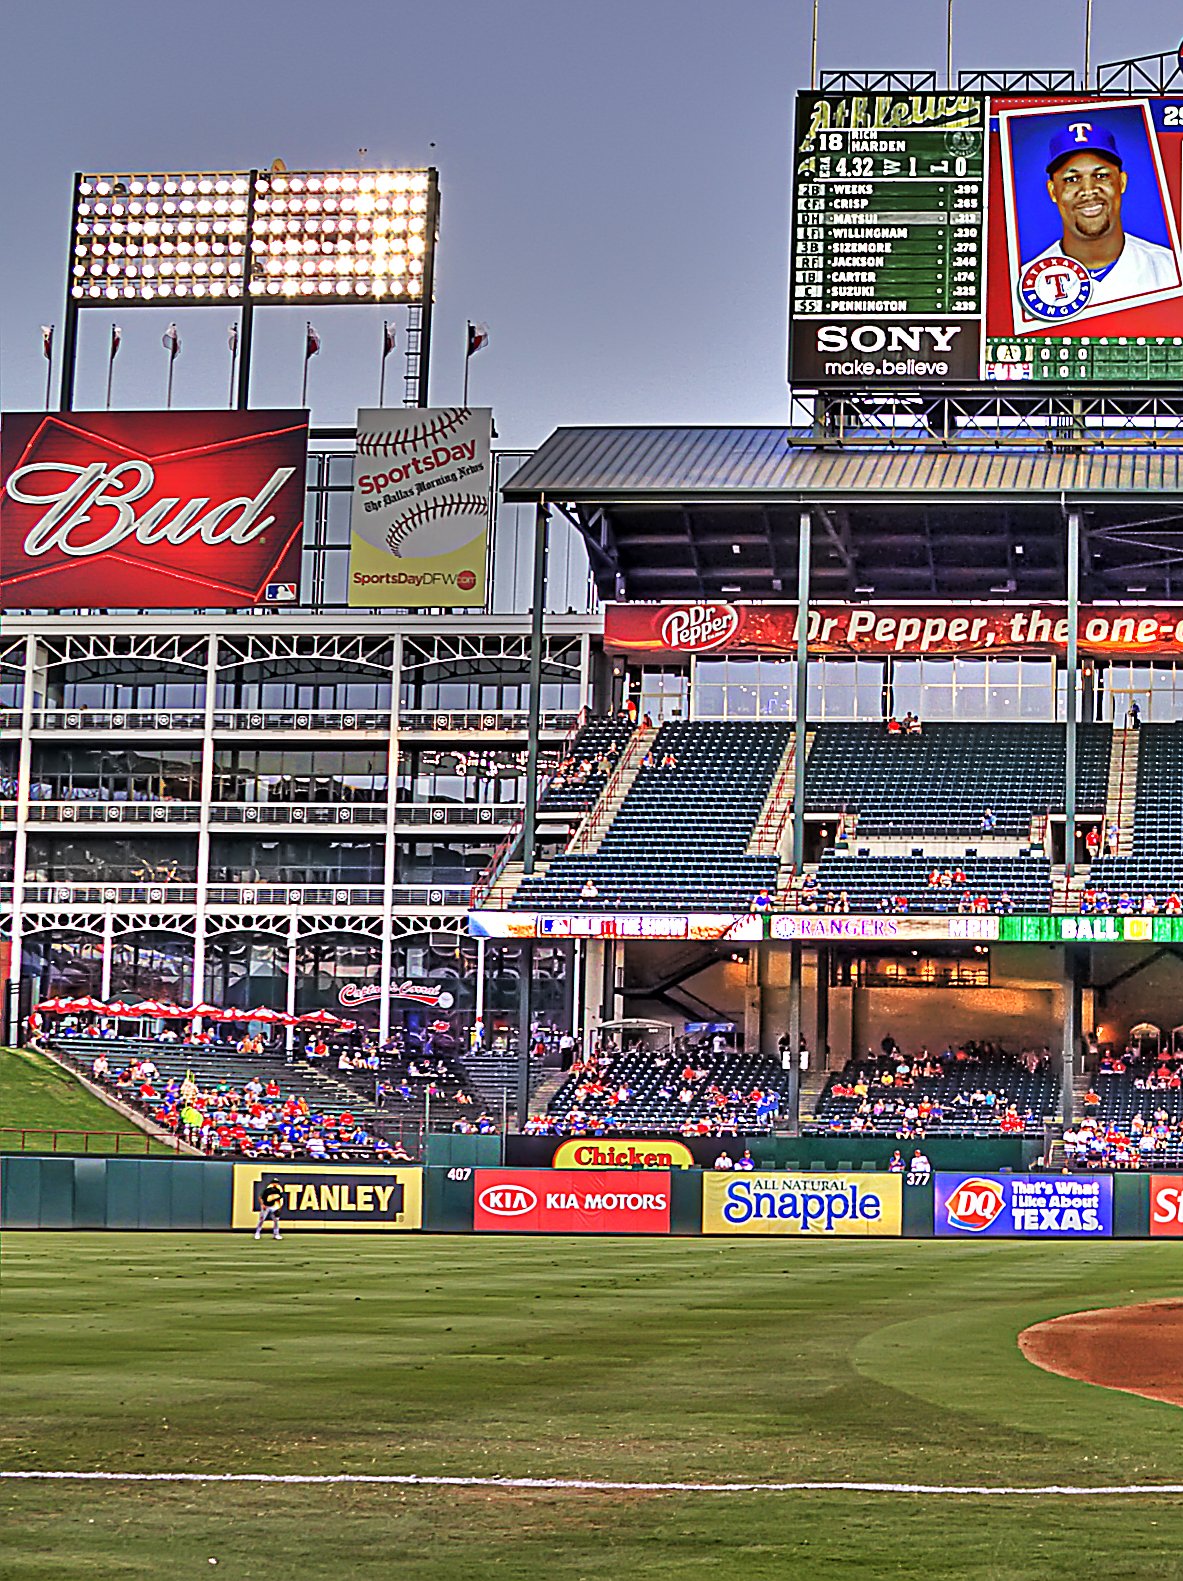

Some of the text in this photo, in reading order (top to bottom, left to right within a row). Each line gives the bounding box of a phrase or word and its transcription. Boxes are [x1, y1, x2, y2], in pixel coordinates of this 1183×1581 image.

[852, 131, 878, 140] RICH
[1068, 122, 1093, 143] T
[819, 133, 843, 151] 18
[852, 141, 906, 152] HARDEN
[835, 157, 967, 177] 4.32 1 0
[834, 184, 874, 194] WEEKS
[834, 198, 869, 209] CRISP
[833, 228, 908, 238] WILLINGHAM
[832, 242, 892, 254] SIZEMORE
[832, 256, 884, 267] JACKSON
[832, 272, 876, 282] CARTER
[831, 286, 875, 296] SUZUKI
[1045, 273, 1070, 299] T
[831, 300, 907, 312] PENNINGTON
[817, 325, 962, 353] SONY
[1040, 348, 1051, 360] 0
[1059, 348, 1070, 360] 0
[1078, 348, 1088, 360] 0
[825, 359, 949, 375] make.believe
[1059, 366, 1070, 378] 0
[358, 439, 476, 495] SportsDay
[363, 462, 485, 513] The Dallas Morning News
[6, 460, 297, 557] Bud
[689, 606, 716, 626] Dr
[662, 610, 732, 647] Pepper
[847, 610, 996, 651] Pepper,
[1010, 610, 1069, 642] the
[801, 918, 898, 937] RANGERS
[1061, 918, 1119, 940] BALL
[574, 1147, 672, 1167] Chicken
[447, 1168, 472, 1182] 407
[906, 1173, 930, 1186] 377
[754, 1180, 847, 1191] ALL NATURAL
[1012, 1182, 1099, 1195] That's What
[268, 1183, 395, 1211] TANLEY
[489, 1193, 526, 1209] KIA
[546, 1194, 666, 1210] KIA MOTORS
[956, 1190, 995, 1218] DQ
[1018, 1196, 1046, 1208] Like
[1048, 1196, 1099, 1208] About
[724, 1182, 880, 1231] Snapple
[1012, 1210, 1104, 1231] TEXAS.
